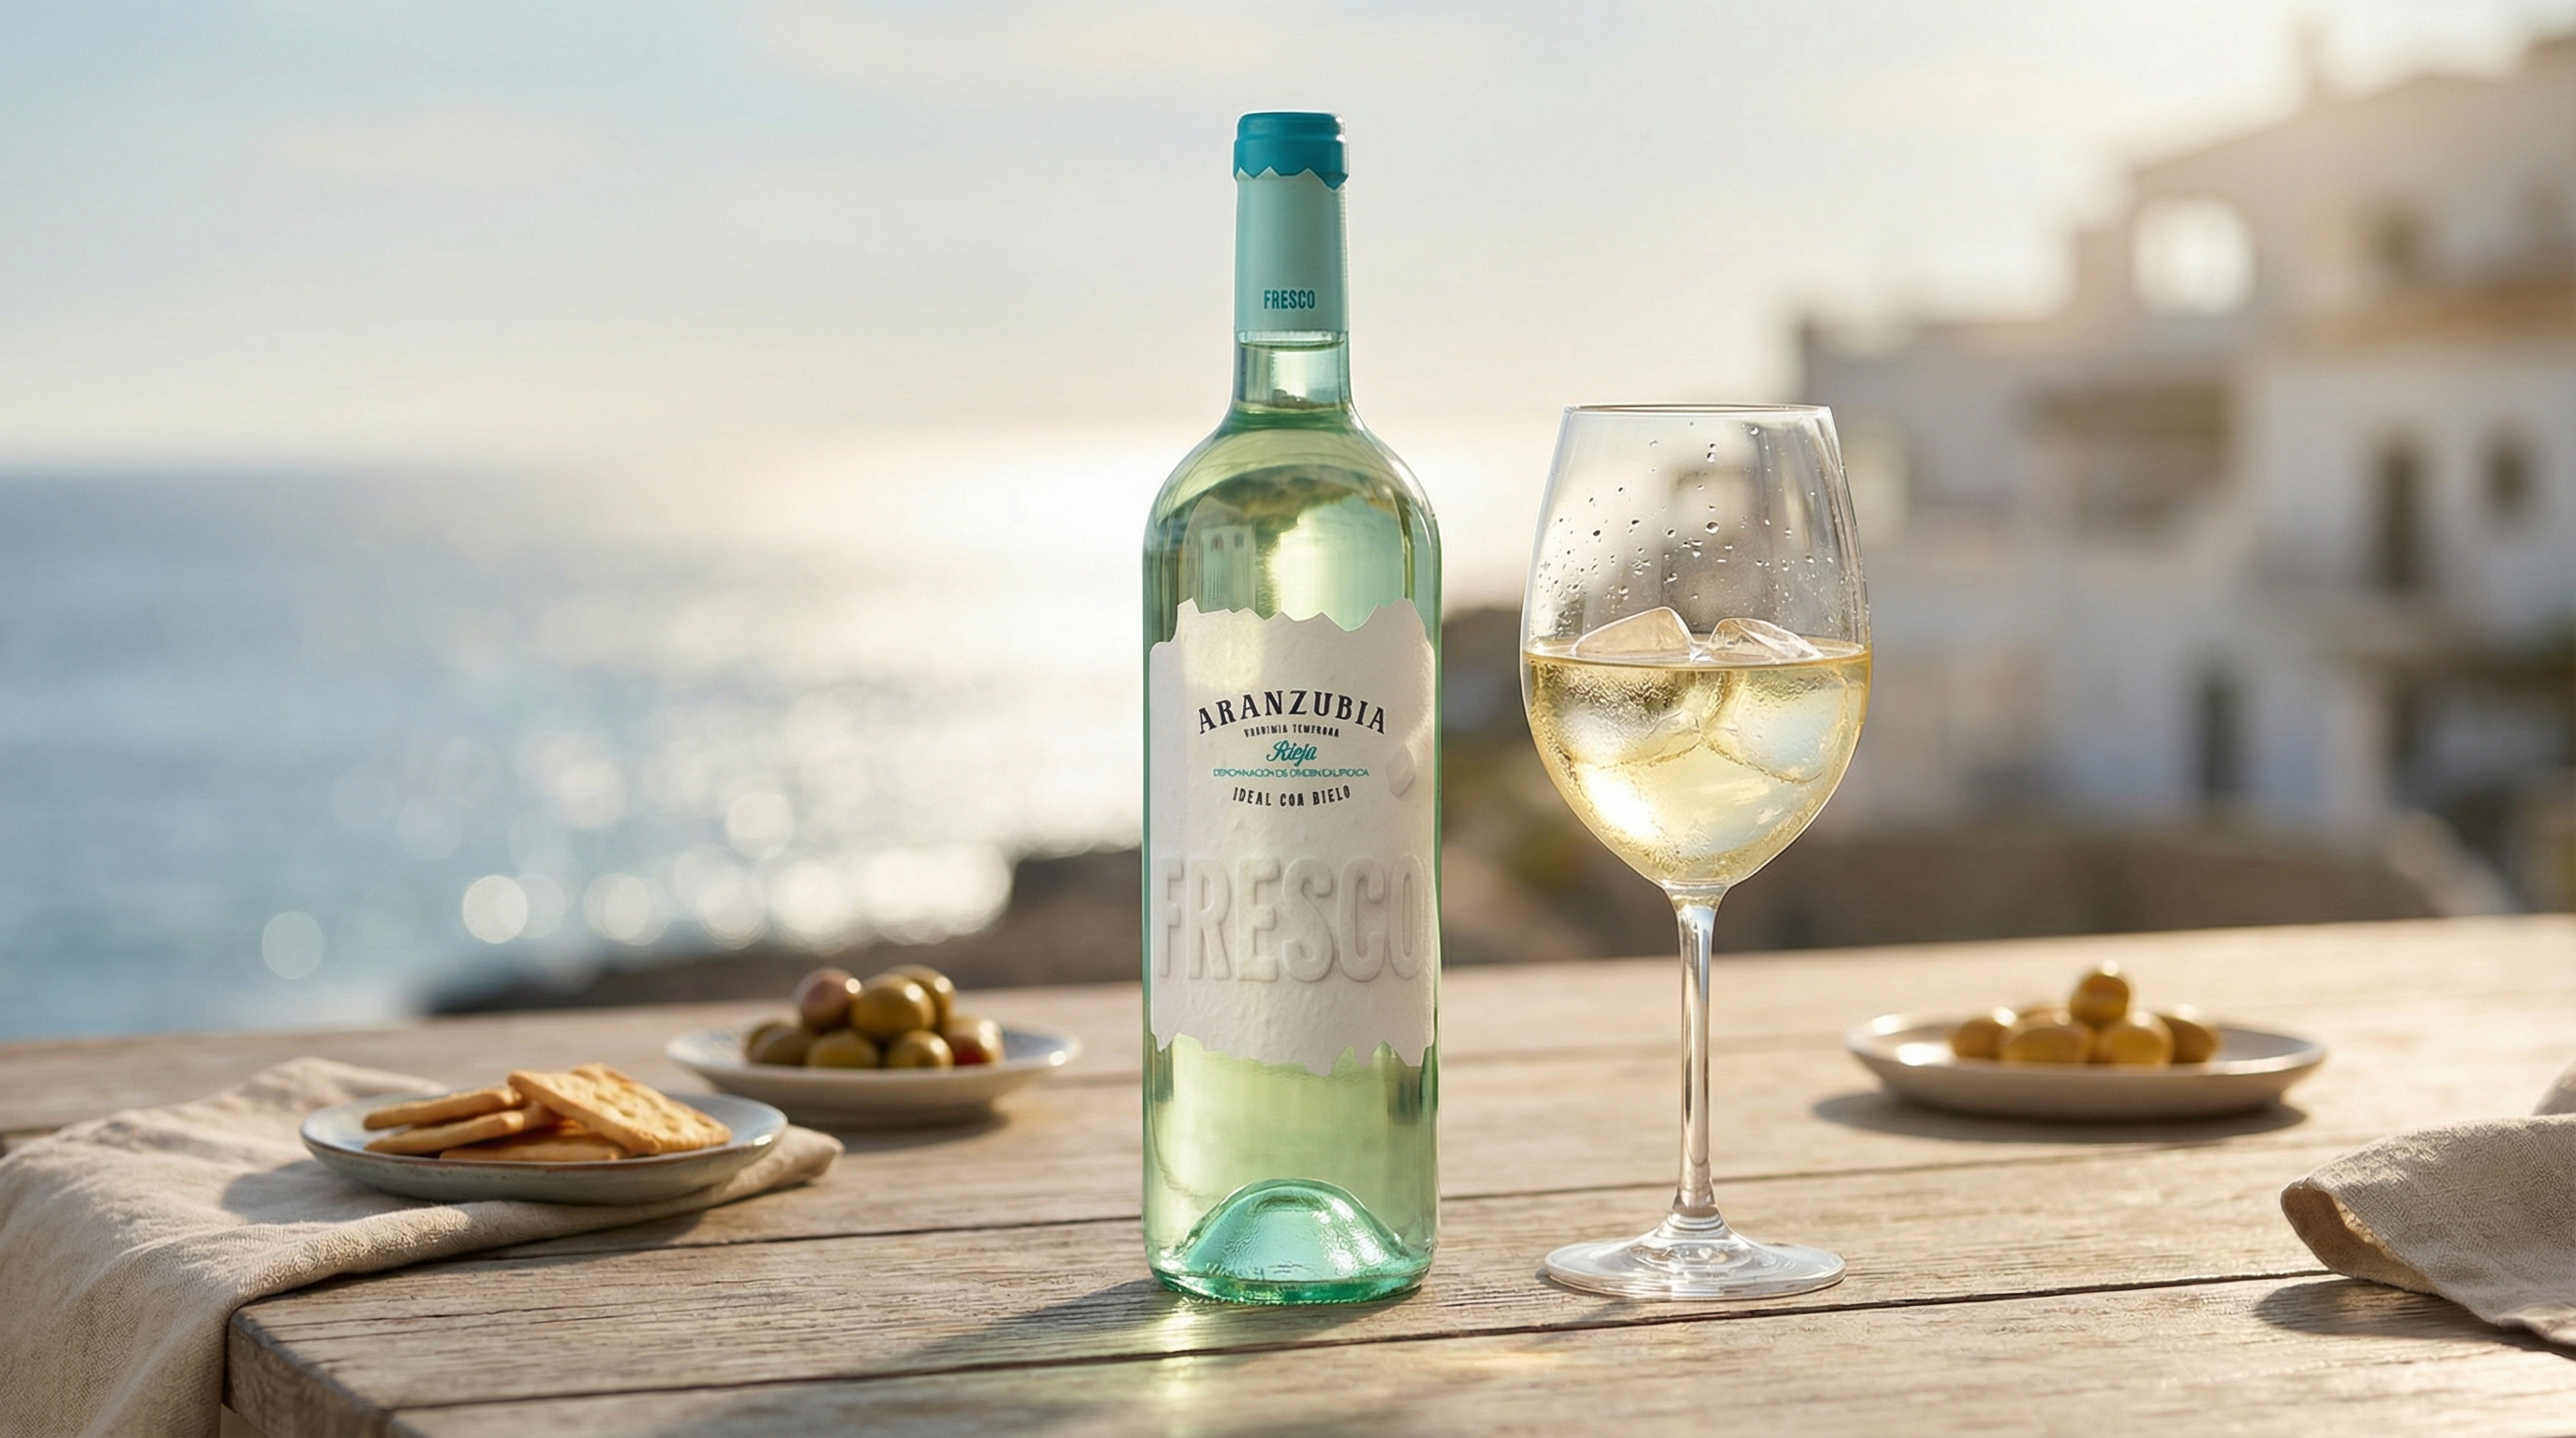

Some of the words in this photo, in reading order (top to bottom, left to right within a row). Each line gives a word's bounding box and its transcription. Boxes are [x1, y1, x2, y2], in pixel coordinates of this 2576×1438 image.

[1264, 289, 1315, 309] FRESCO
[1197, 690, 1385, 735] ARANZUBIA
[1233, 786, 1272, 806] IDEAL
[1158, 854, 1426, 983] FRESCO
